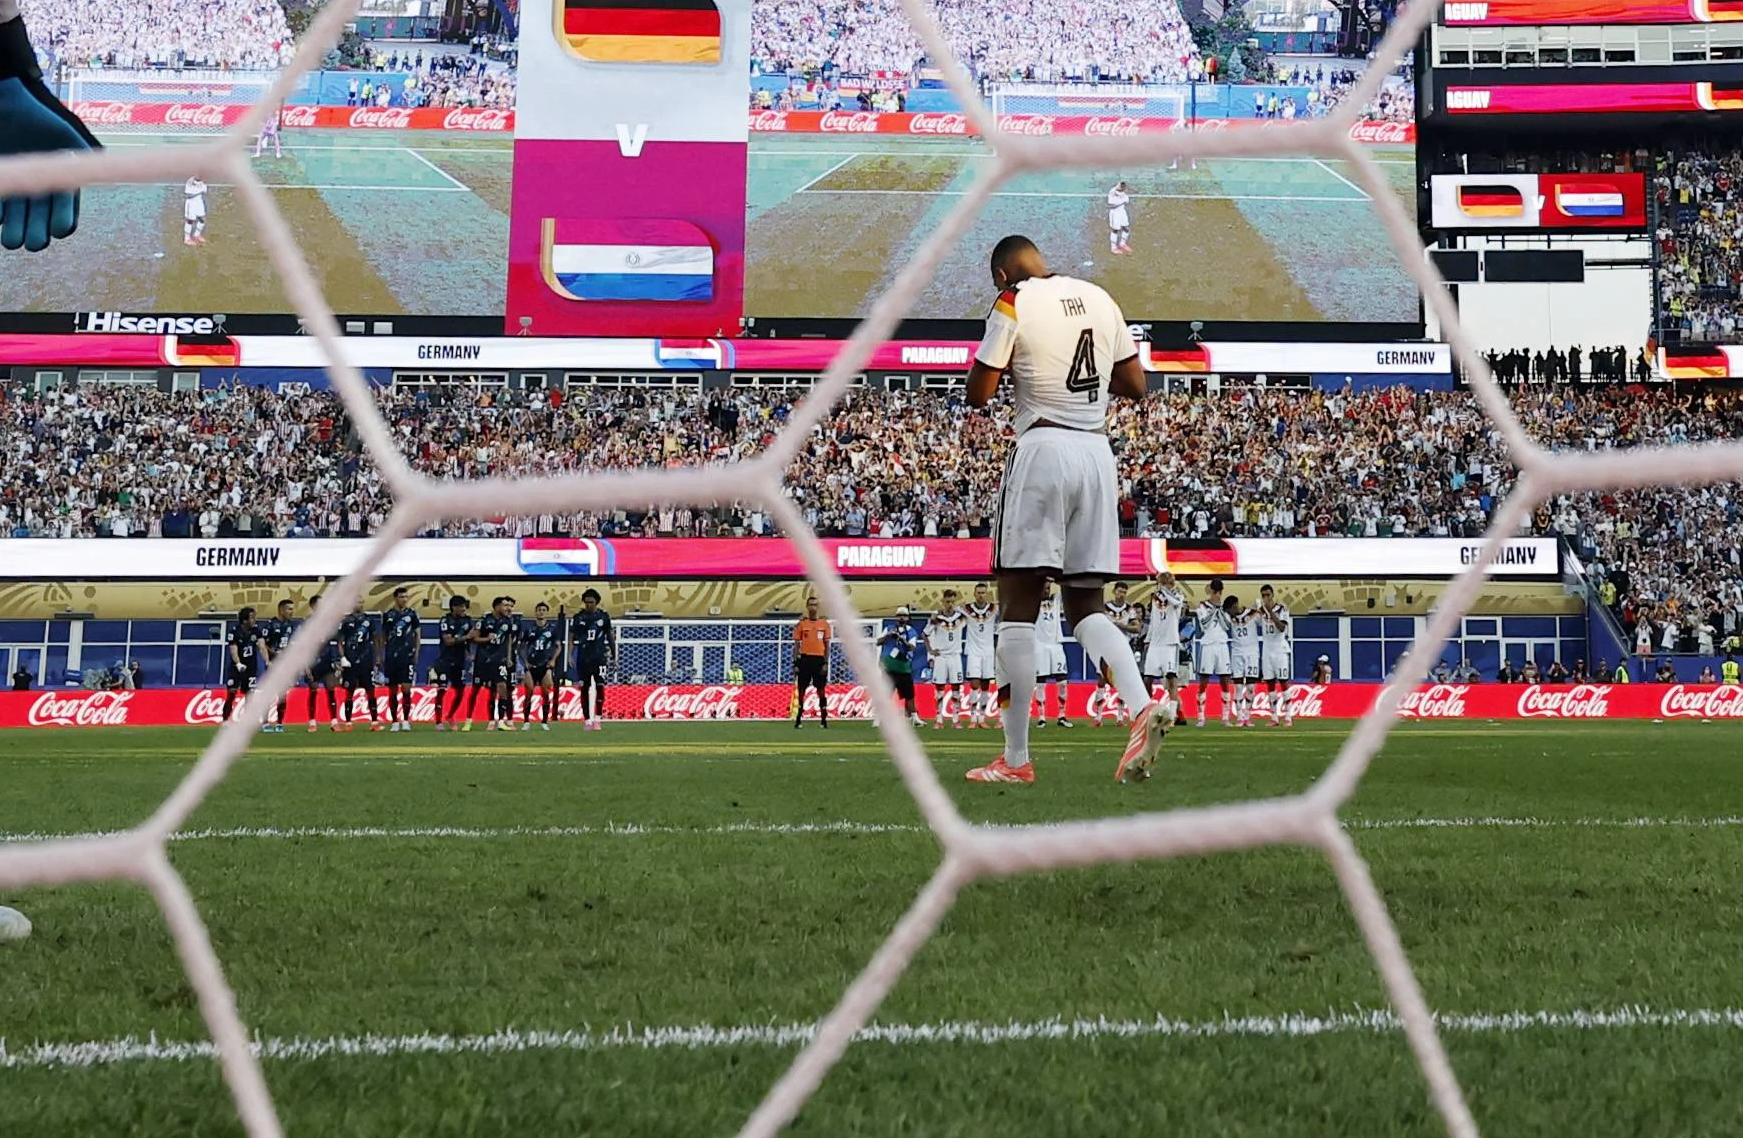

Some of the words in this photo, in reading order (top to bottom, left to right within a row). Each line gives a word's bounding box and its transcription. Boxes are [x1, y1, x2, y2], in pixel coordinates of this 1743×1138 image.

[1060, 297, 1086, 317] TAH
[87, 312, 213, 335] Hisense
[417, 344, 481, 360] GERMANY
[901, 346, 969, 364] PARAGUAY
[1066, 326, 1100, 393] 4
[1376, 350, 1436, 366] GERMANY
[195, 546, 280, 568] GERMANY
[837, 545, 926, 568] PARAGUAY
[396, 625, 403, 637] 5
[1237, 627, 1248, 637] 20
[28, 691, 135, 726] Coca-Cola
[1518, 685, 1613, 718] Coca-Cola
